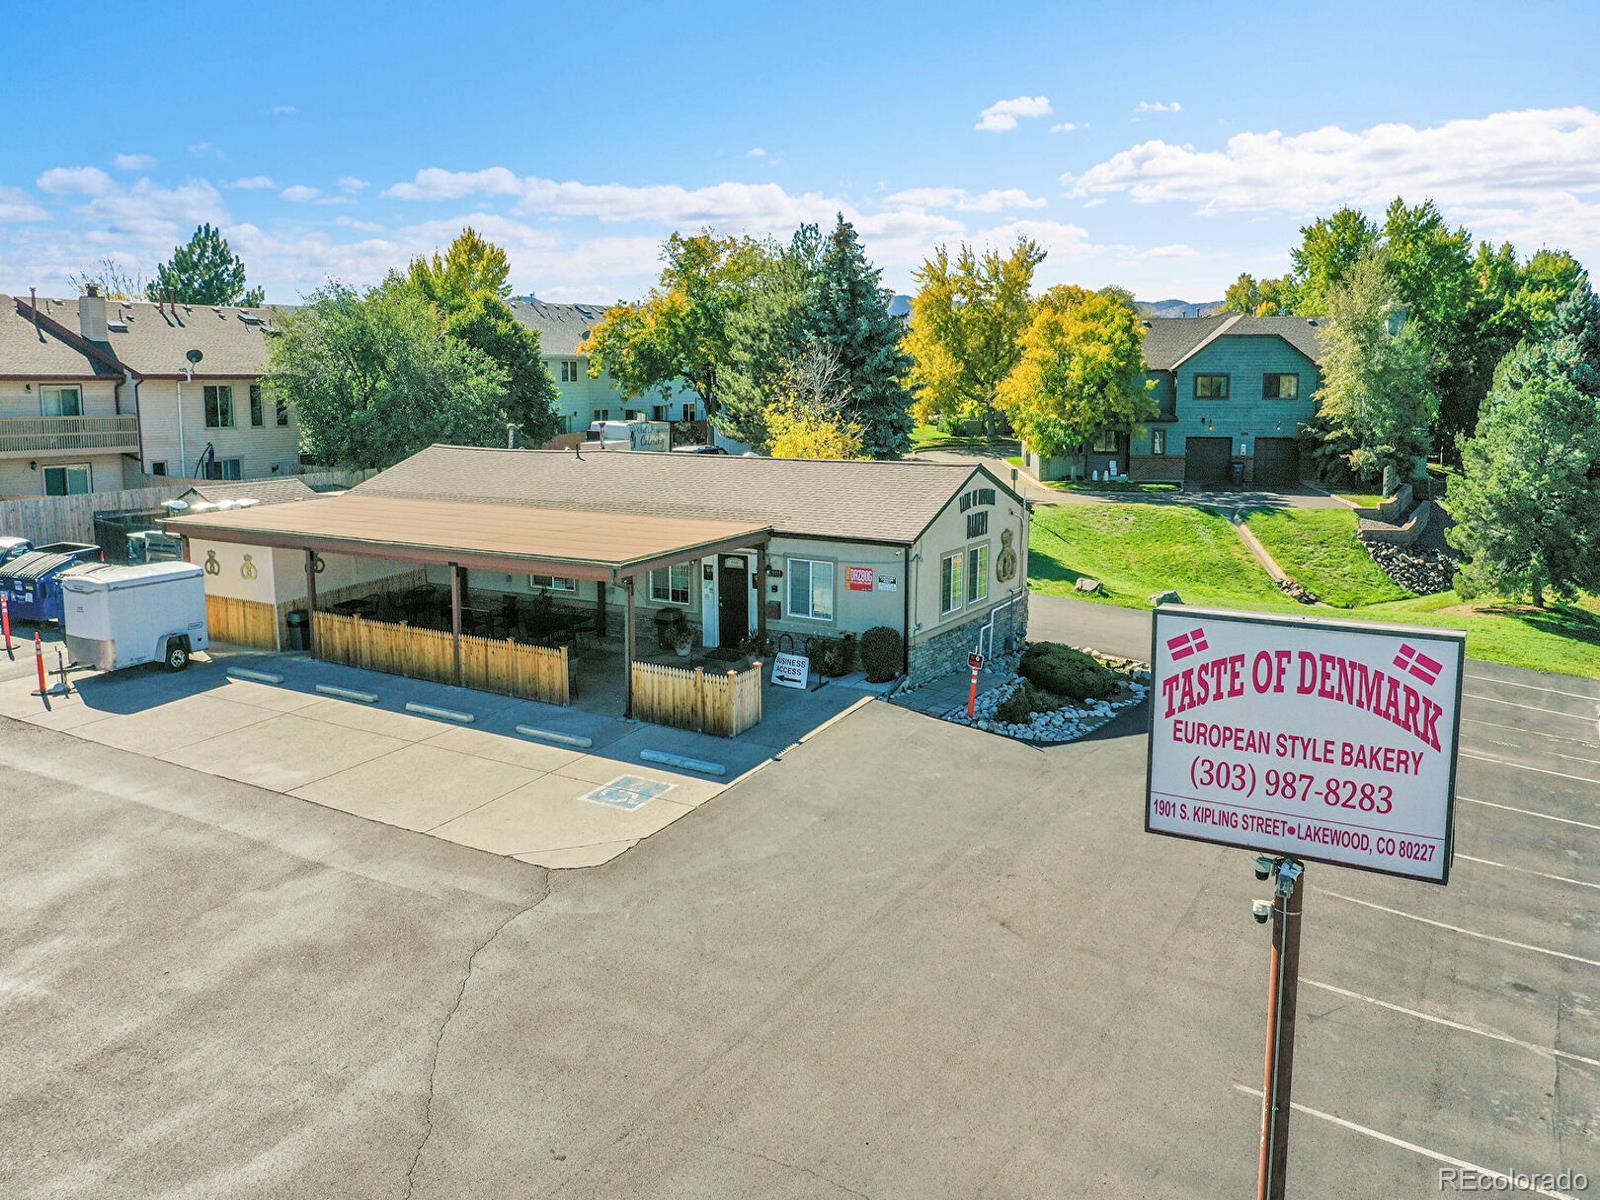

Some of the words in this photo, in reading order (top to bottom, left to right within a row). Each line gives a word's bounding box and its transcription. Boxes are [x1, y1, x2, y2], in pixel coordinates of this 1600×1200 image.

[776, 657, 806, 668] BUSINESS
[777, 665, 802, 676] ACCESS
[1162, 653, 1245, 719] TASTE
[1252, 650, 1292, 694] OF
[1297, 650, 1443, 752] DENMARK
[1173, 719, 1271, 755] EUROPEAN
[1276, 734, 1335, 764] STYLE
[1341, 742, 1424, 775] BAKERY
[1190, 755, 1257, 798] (303)
[1265, 769, 1393, 814] 987-8283
[1153, 799, 1177, 819] 1901
[1179, 805, 1190, 821] S.
[1193, 807, 1238, 829] KIPLING
[1376, 840, 1396, 855] CO
[1399, 841, 1435, 862] 80227
